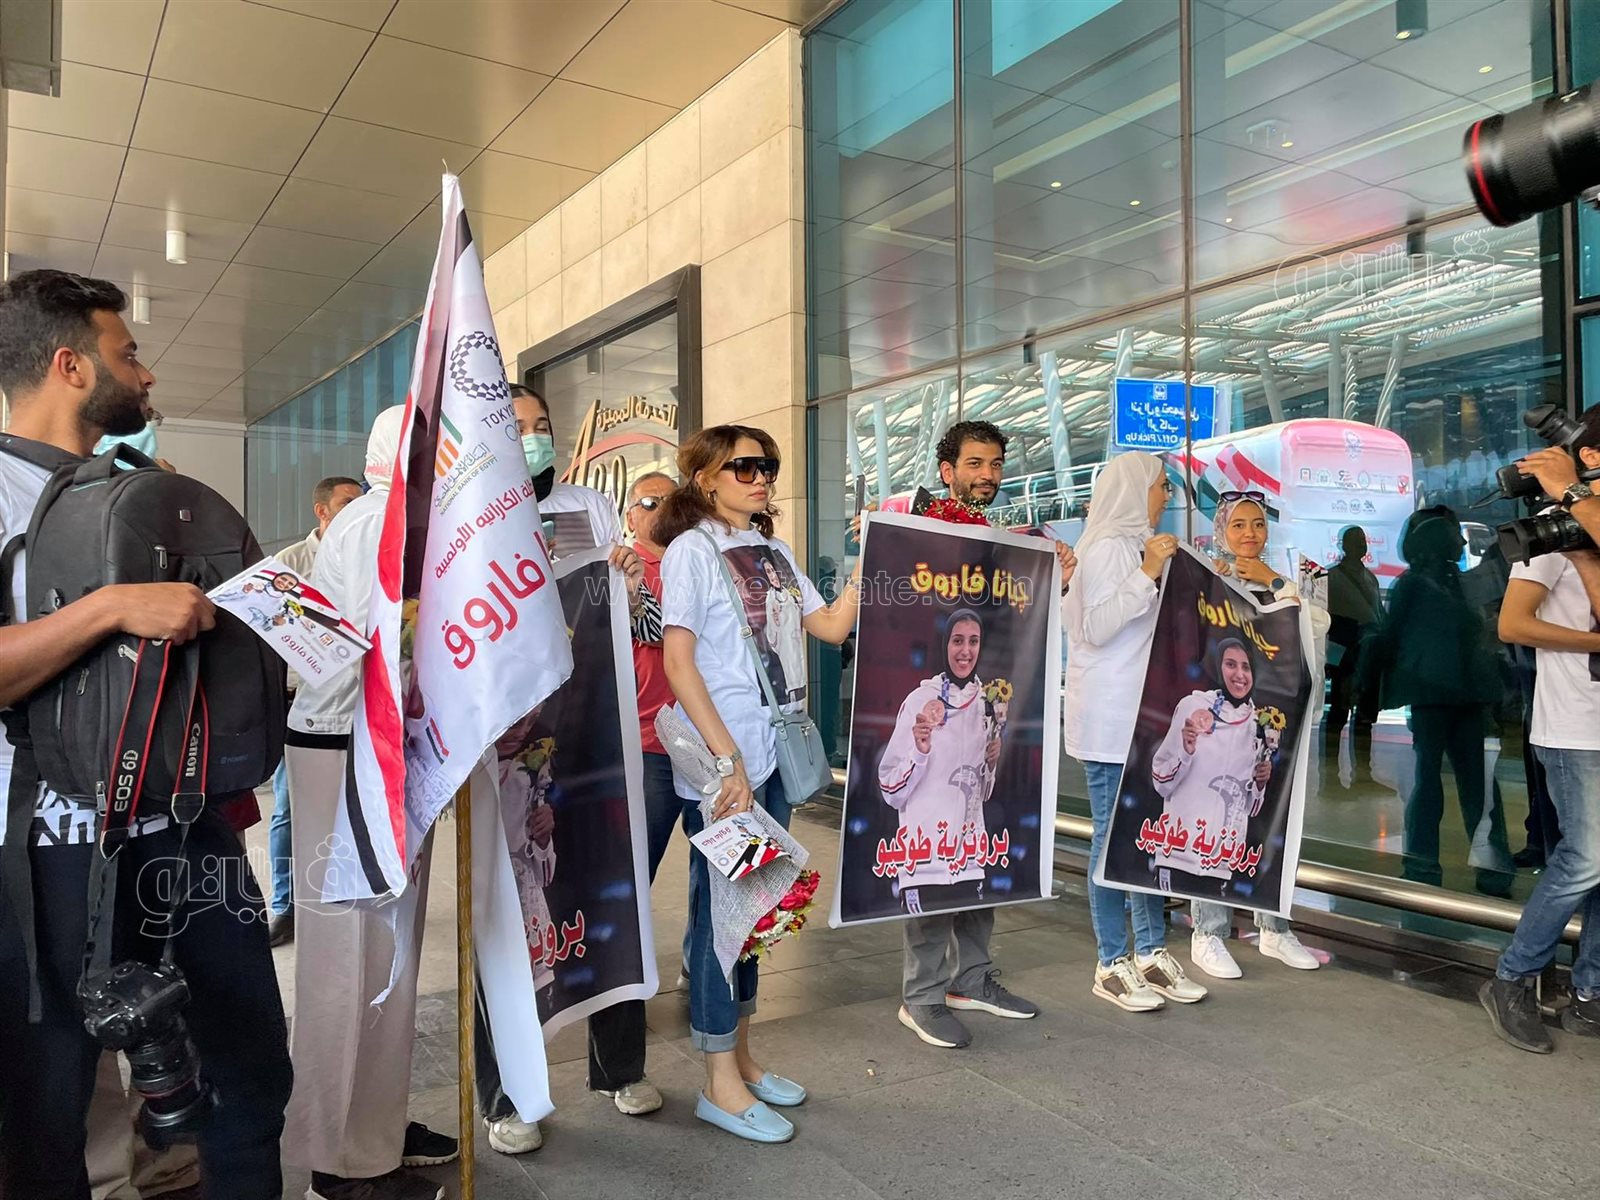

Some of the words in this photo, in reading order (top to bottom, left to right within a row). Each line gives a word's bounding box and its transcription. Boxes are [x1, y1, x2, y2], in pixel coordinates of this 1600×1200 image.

[440, 491, 458, 515] NATIONAL
[458, 476, 472, 491] BANK
[479, 456, 498, 472] EGYPT
[475, 488, 522, 527] الكاراتيه
[910, 562, 985, 599] فاروق
[441, 552, 546, 670] فاروق
[121, 749, 139, 771] 6D
[185, 722, 201, 777] Canon
[114, 774, 134, 812] EOS
[872, 825, 932, 878] طوكيو
[936, 820, 1010, 875] برونزية
[1135, 813, 1190, 857] طوكيو
[1192, 818, 1263, 878] برونزية
